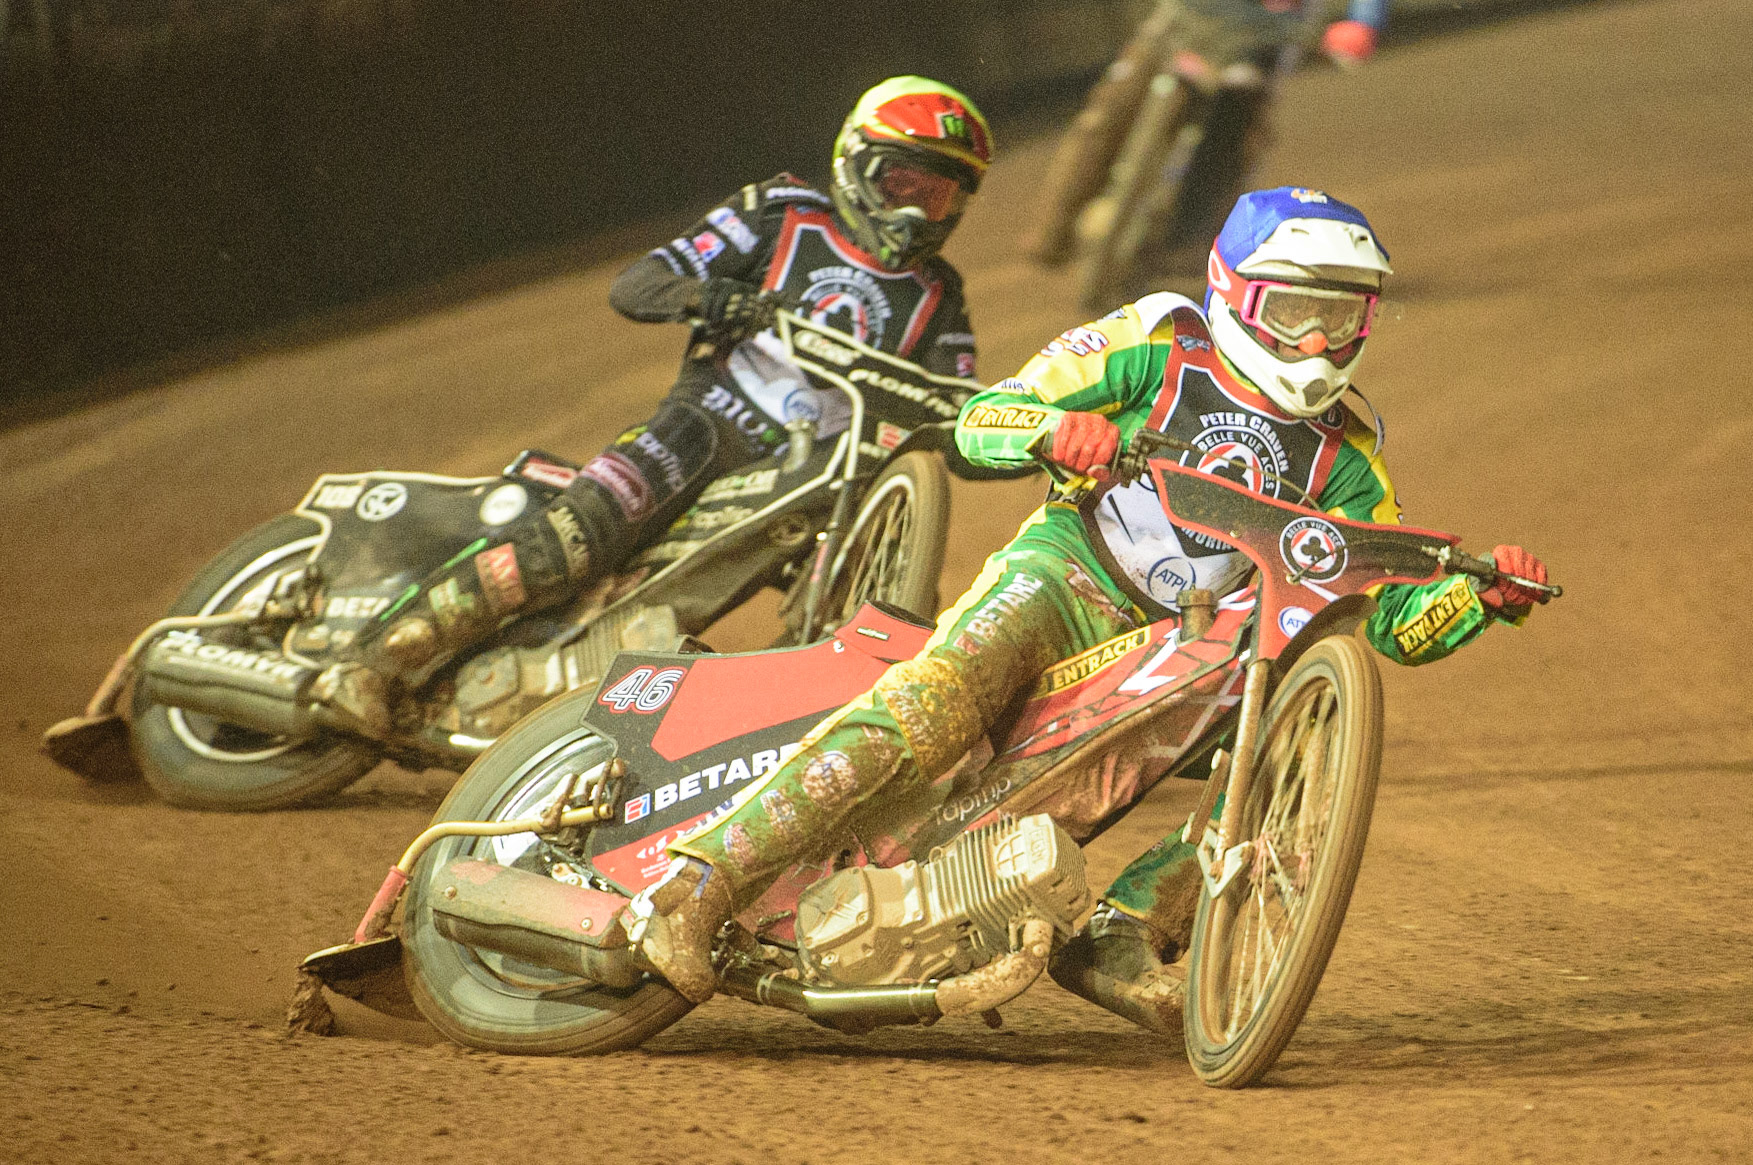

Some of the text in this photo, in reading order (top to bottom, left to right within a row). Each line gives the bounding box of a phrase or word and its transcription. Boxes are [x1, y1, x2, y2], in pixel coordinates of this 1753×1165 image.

[1196, 431, 1275, 490] BELLE VUE ACES
[1199, 411, 1290, 473] PETER CRAVEN
[1285, 520, 1342, 548] BELLE VUE ACE
[1053, 633, 1140, 689] ENTRACK
[601, 667, 686, 712] 46
